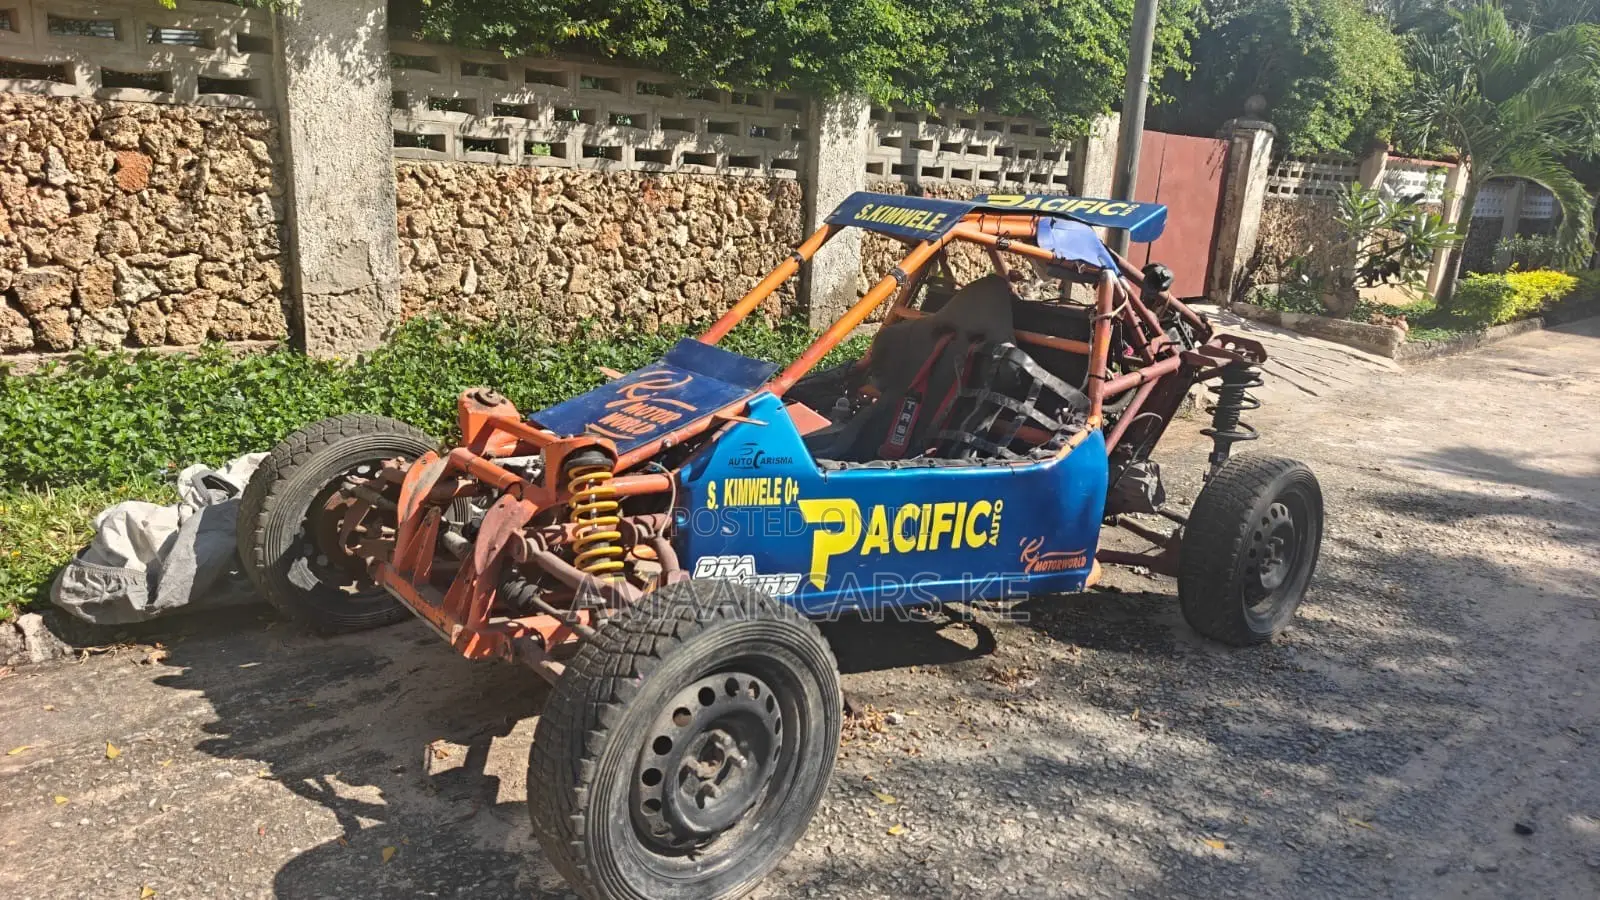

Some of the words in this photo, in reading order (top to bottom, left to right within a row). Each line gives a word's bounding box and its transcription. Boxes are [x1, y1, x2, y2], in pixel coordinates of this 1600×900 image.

[853, 203, 948, 232] S.KIMWELE
[597, 412, 657, 435] WORLD
[620, 402, 683, 425] MOTOR
[707, 481, 719, 510] S.
[723, 477, 783, 507] KIMWELE
[797, 498, 992, 592] PACIFIC
[988, 499, 1004, 546] AUTO
[1033, 556, 1088, 573] MOTORWORLD
